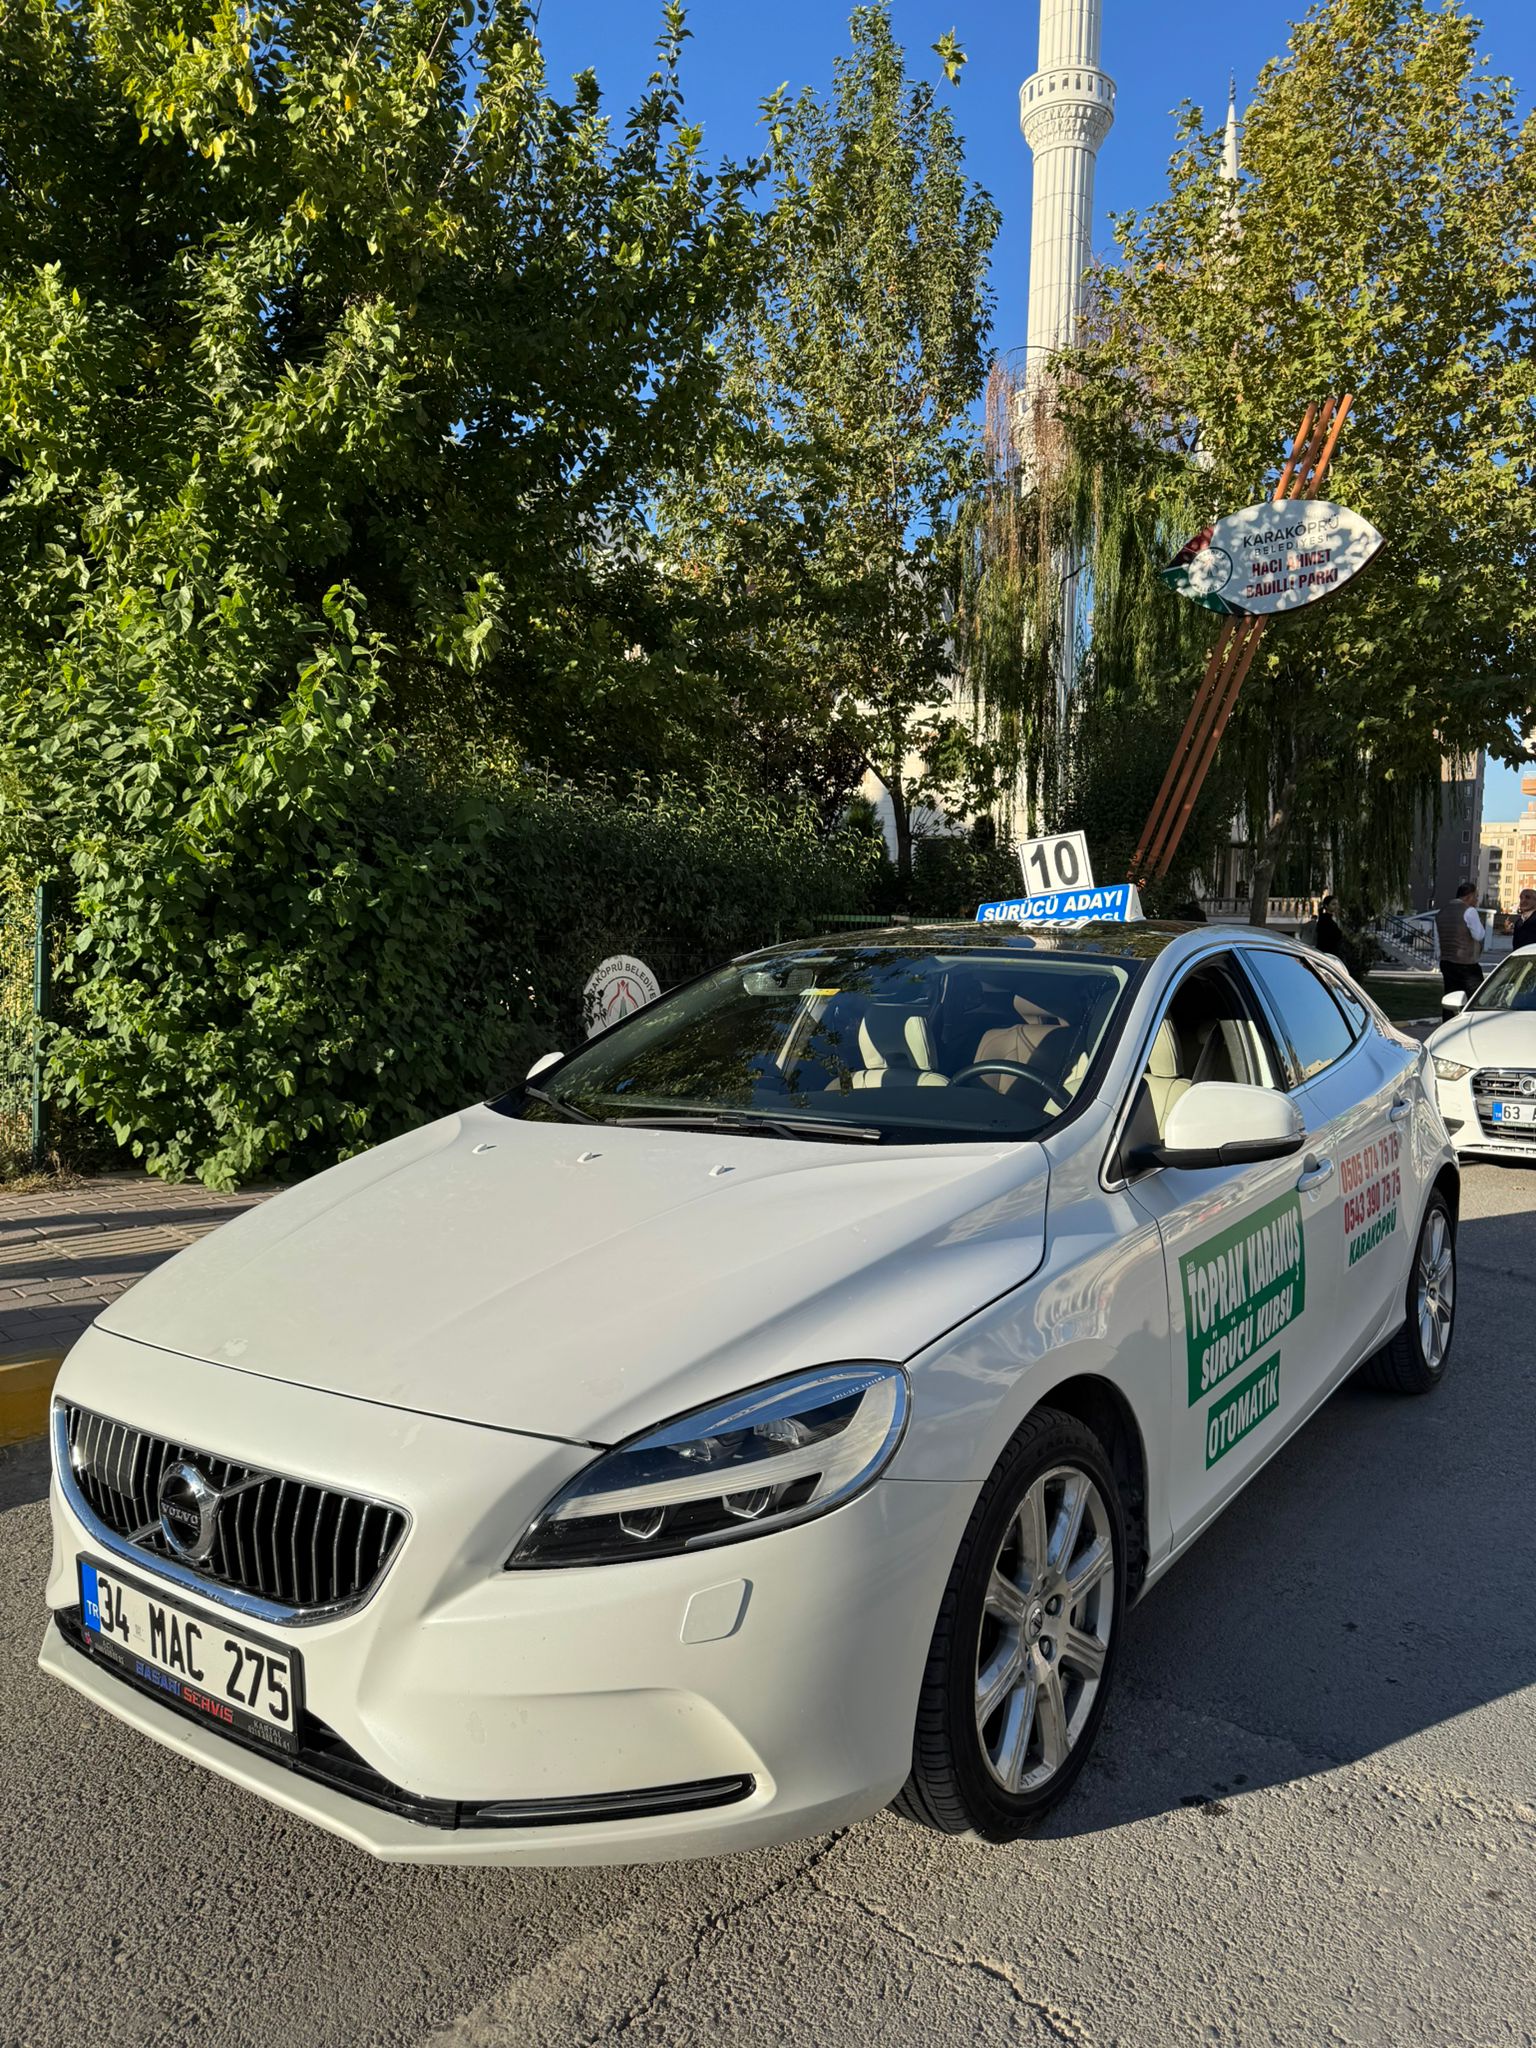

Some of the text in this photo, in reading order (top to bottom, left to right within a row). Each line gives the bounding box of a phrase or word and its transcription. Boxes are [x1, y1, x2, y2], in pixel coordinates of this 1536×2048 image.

[1243, 514, 1339, 548] KARAKÖPRÜ
[1252, 559, 1282, 576] HACI
[1298, 568, 1339, 588] PARKI
[1030, 840, 1080, 889] 10
[983, 895, 1059, 921] SÜRÜCÜ
[1063, 890, 1123, 912] ADAYI
[625, 963, 657, 1001] BELEDİYE
[1503, 1105, 1520, 1120] 63
[1341, 1131, 1399, 1194] 0505 974 75 75
[1344, 1166, 1401, 1235] 0543 390 75 75
[1348, 1201, 1397, 1267] KARAKÖPRÜ
[1187, 1205, 1300, 1340] TOPRAK KARAKUŞ
[1201, 1282, 1294, 1391] SÜRÜCÜ KURSU
[1208, 1363, 1279, 1460] OTOMATİK
[160, 1501, 199, 1525] VOLVO
[86, 1599, 100, 1619] TR
[98, 1576, 289, 1722] 34 MAC 275
